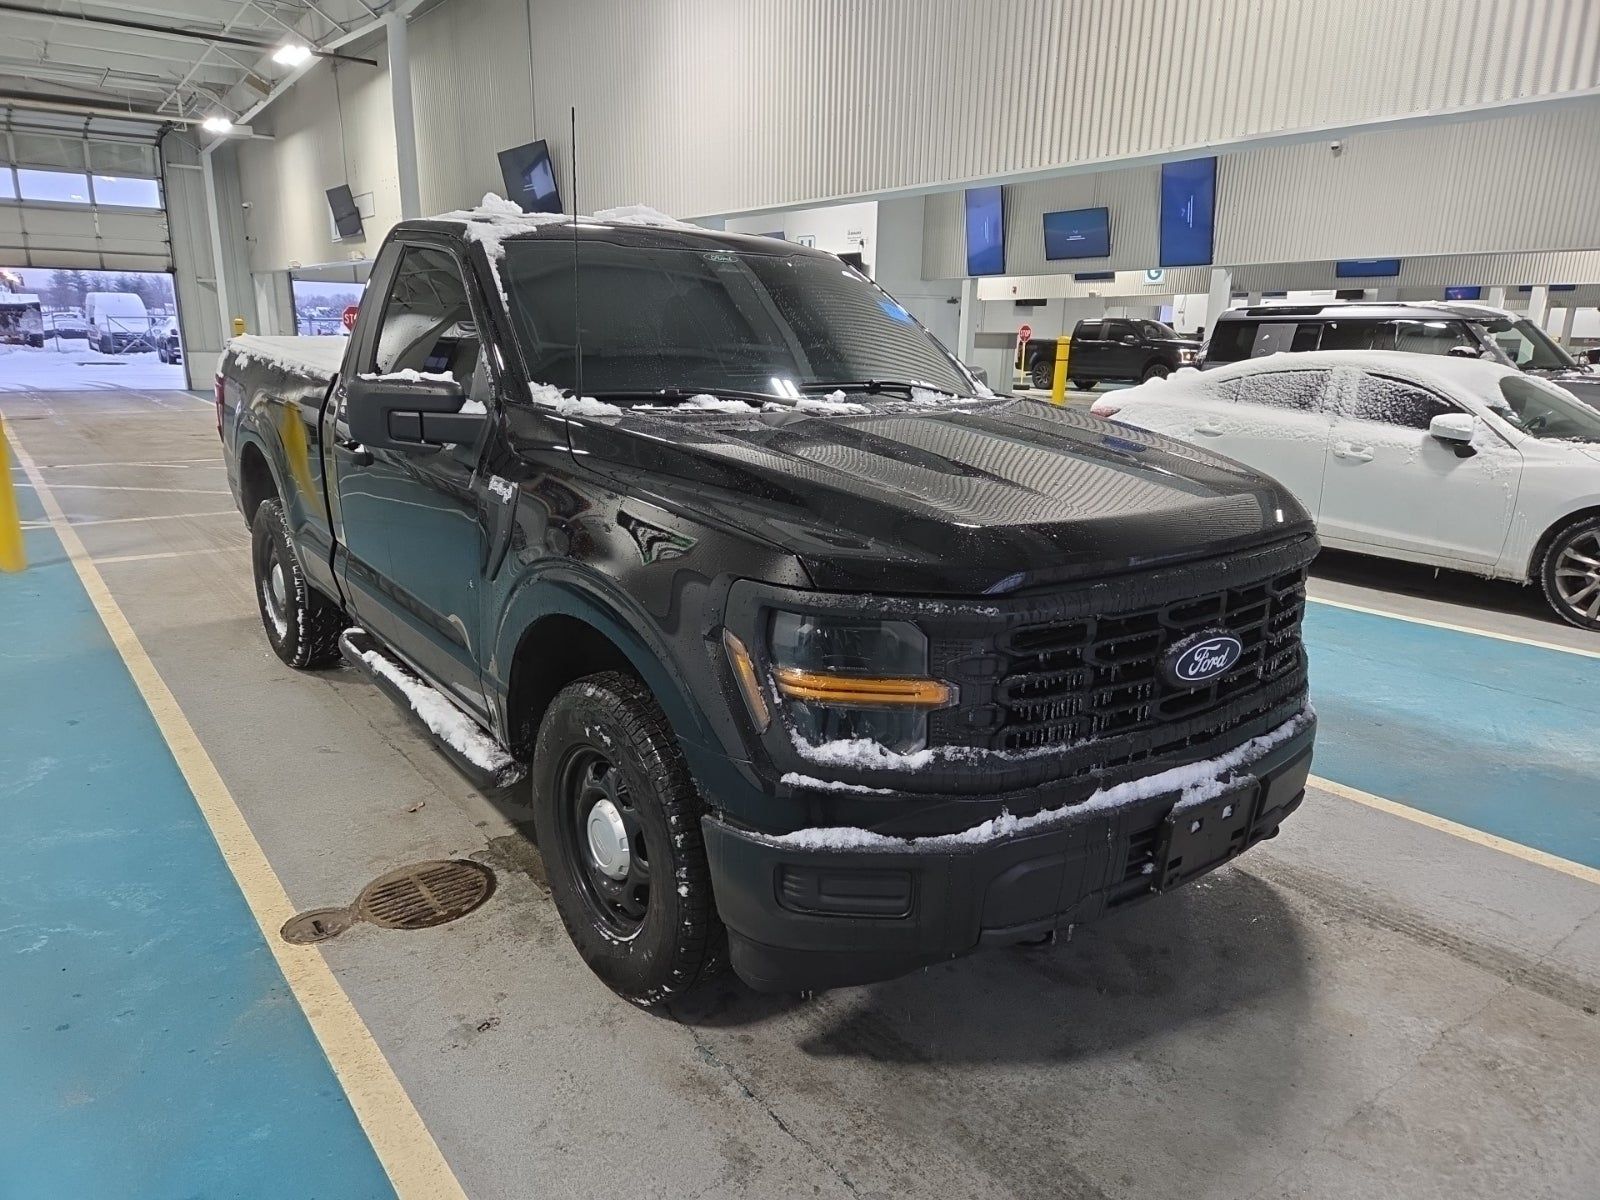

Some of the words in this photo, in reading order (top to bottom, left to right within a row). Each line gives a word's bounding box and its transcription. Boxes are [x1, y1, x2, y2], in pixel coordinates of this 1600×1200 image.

[344, 313, 358, 324] ST
[1020, 329, 1031, 337] STOP
[1188, 643, 1230, 675] Ford
